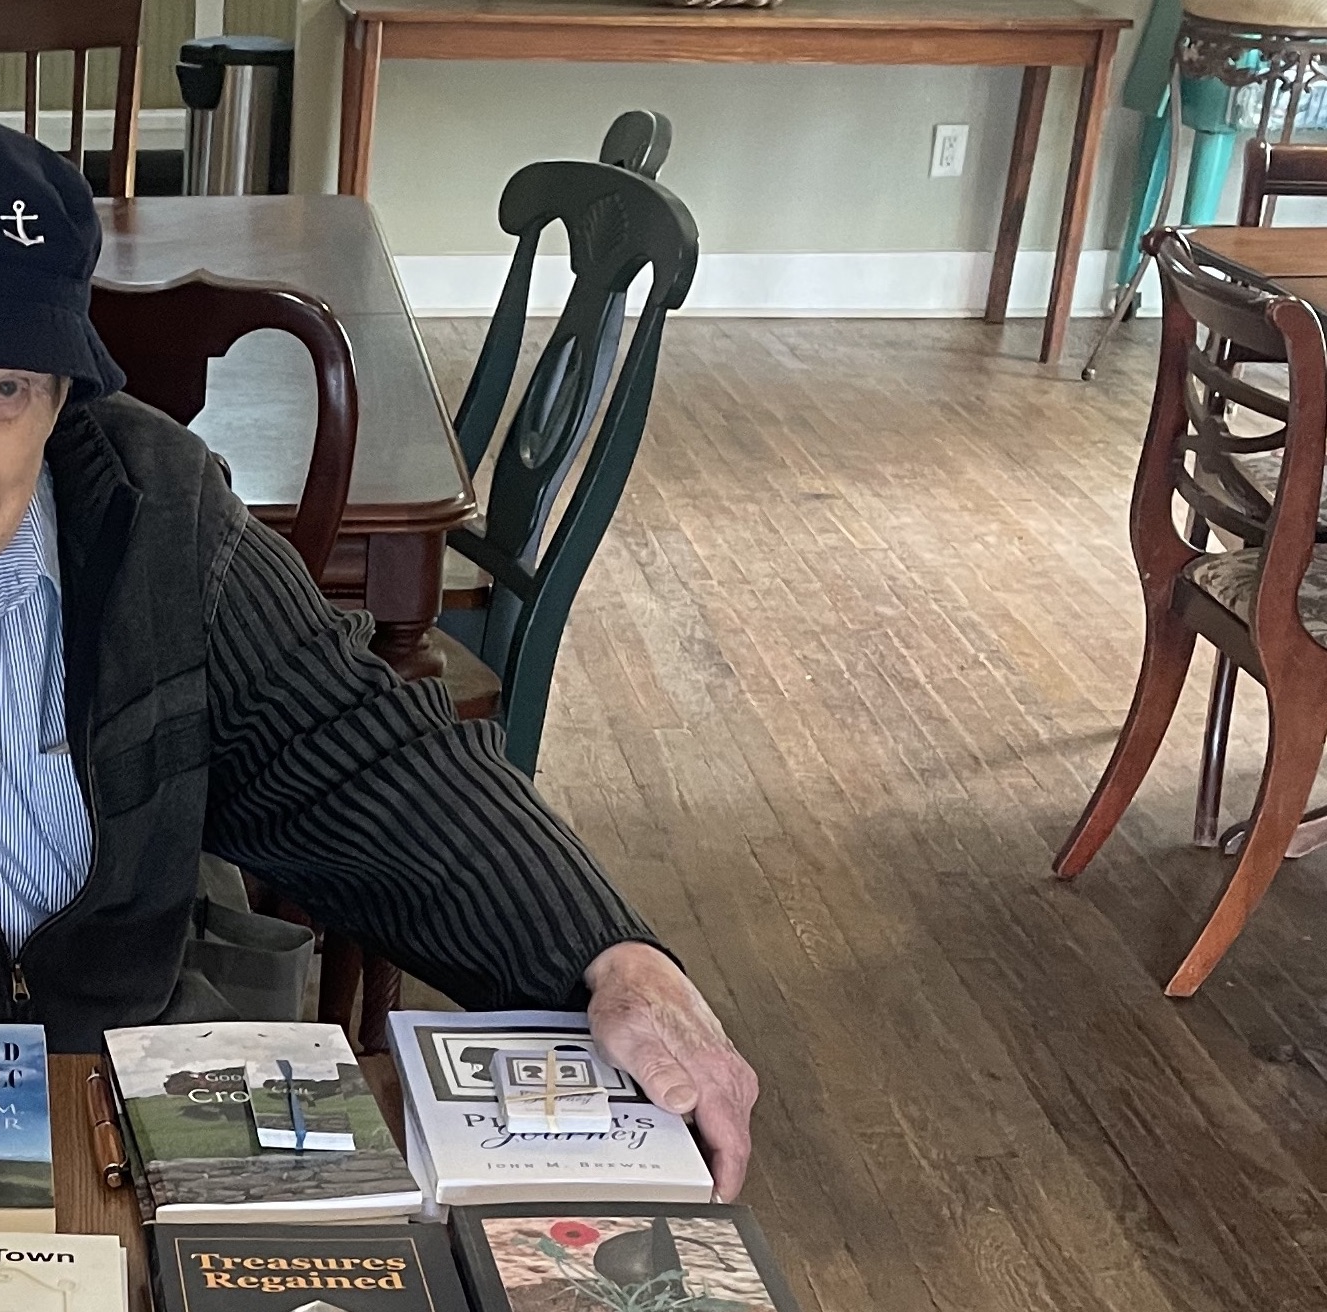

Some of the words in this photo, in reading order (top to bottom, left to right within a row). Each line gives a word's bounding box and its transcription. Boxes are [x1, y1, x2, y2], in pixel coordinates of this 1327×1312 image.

[188, 1088, 251, 1104] Cro
[190, 1252, 408, 1271] Treasures
[202, 1271, 407, 1293] Regained
